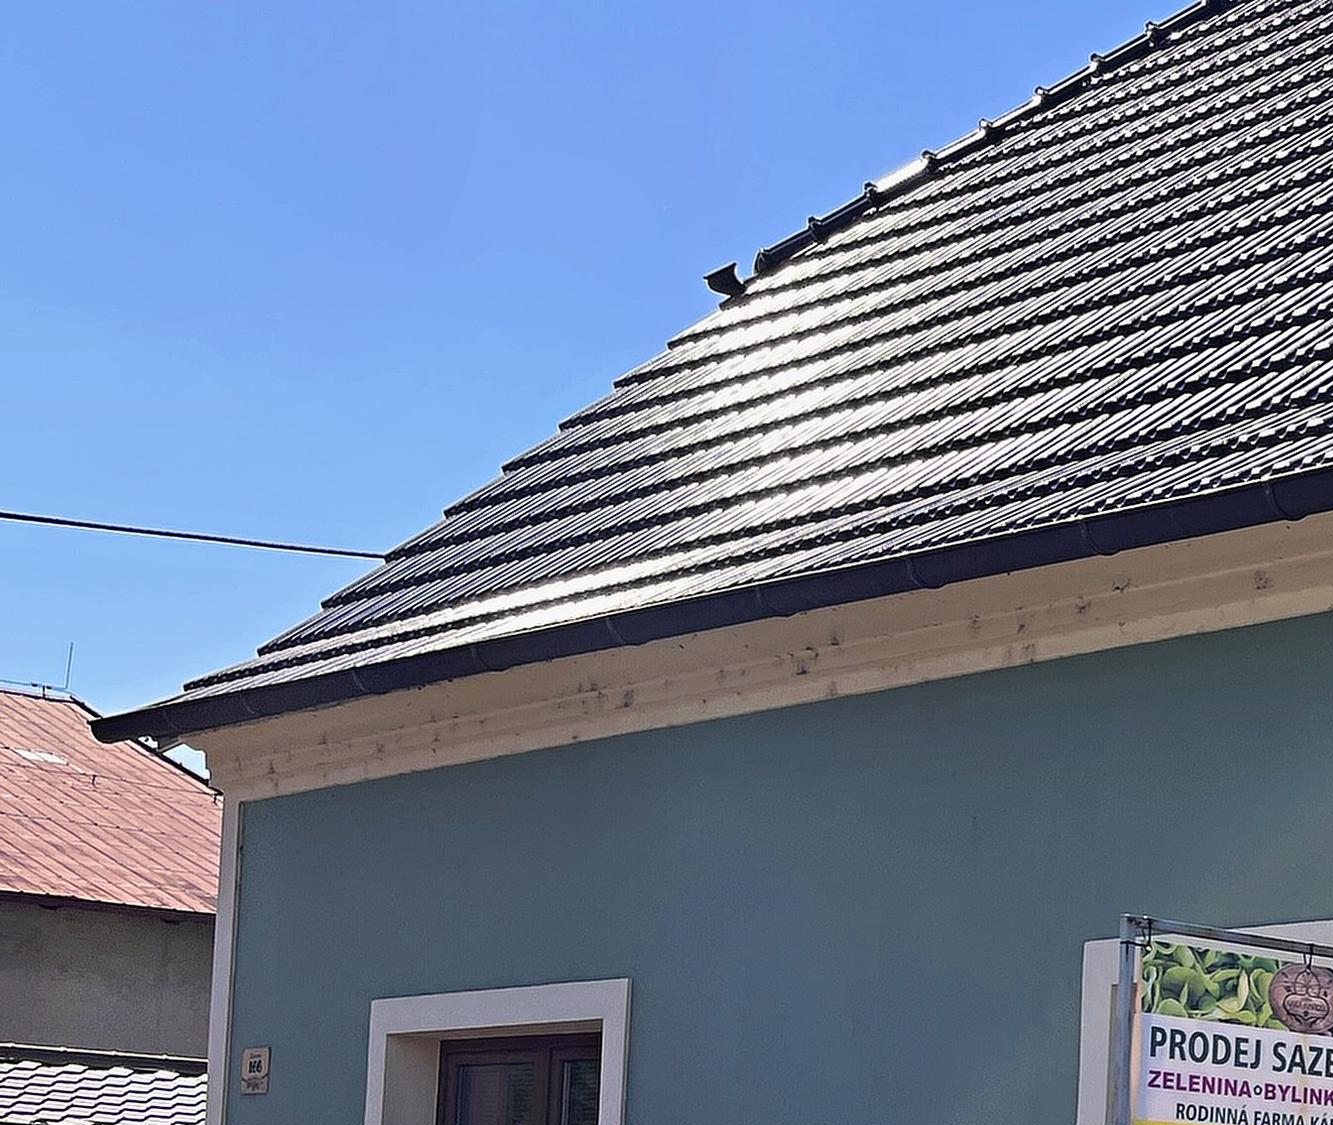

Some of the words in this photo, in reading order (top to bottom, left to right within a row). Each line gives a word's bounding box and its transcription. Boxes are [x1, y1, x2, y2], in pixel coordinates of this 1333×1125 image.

[1150, 1026, 1262, 1069] PRODEJ
[1148, 1070, 1251, 1098] ZELENINA
[1176, 1103, 1248, 1125] RODINNÁ
